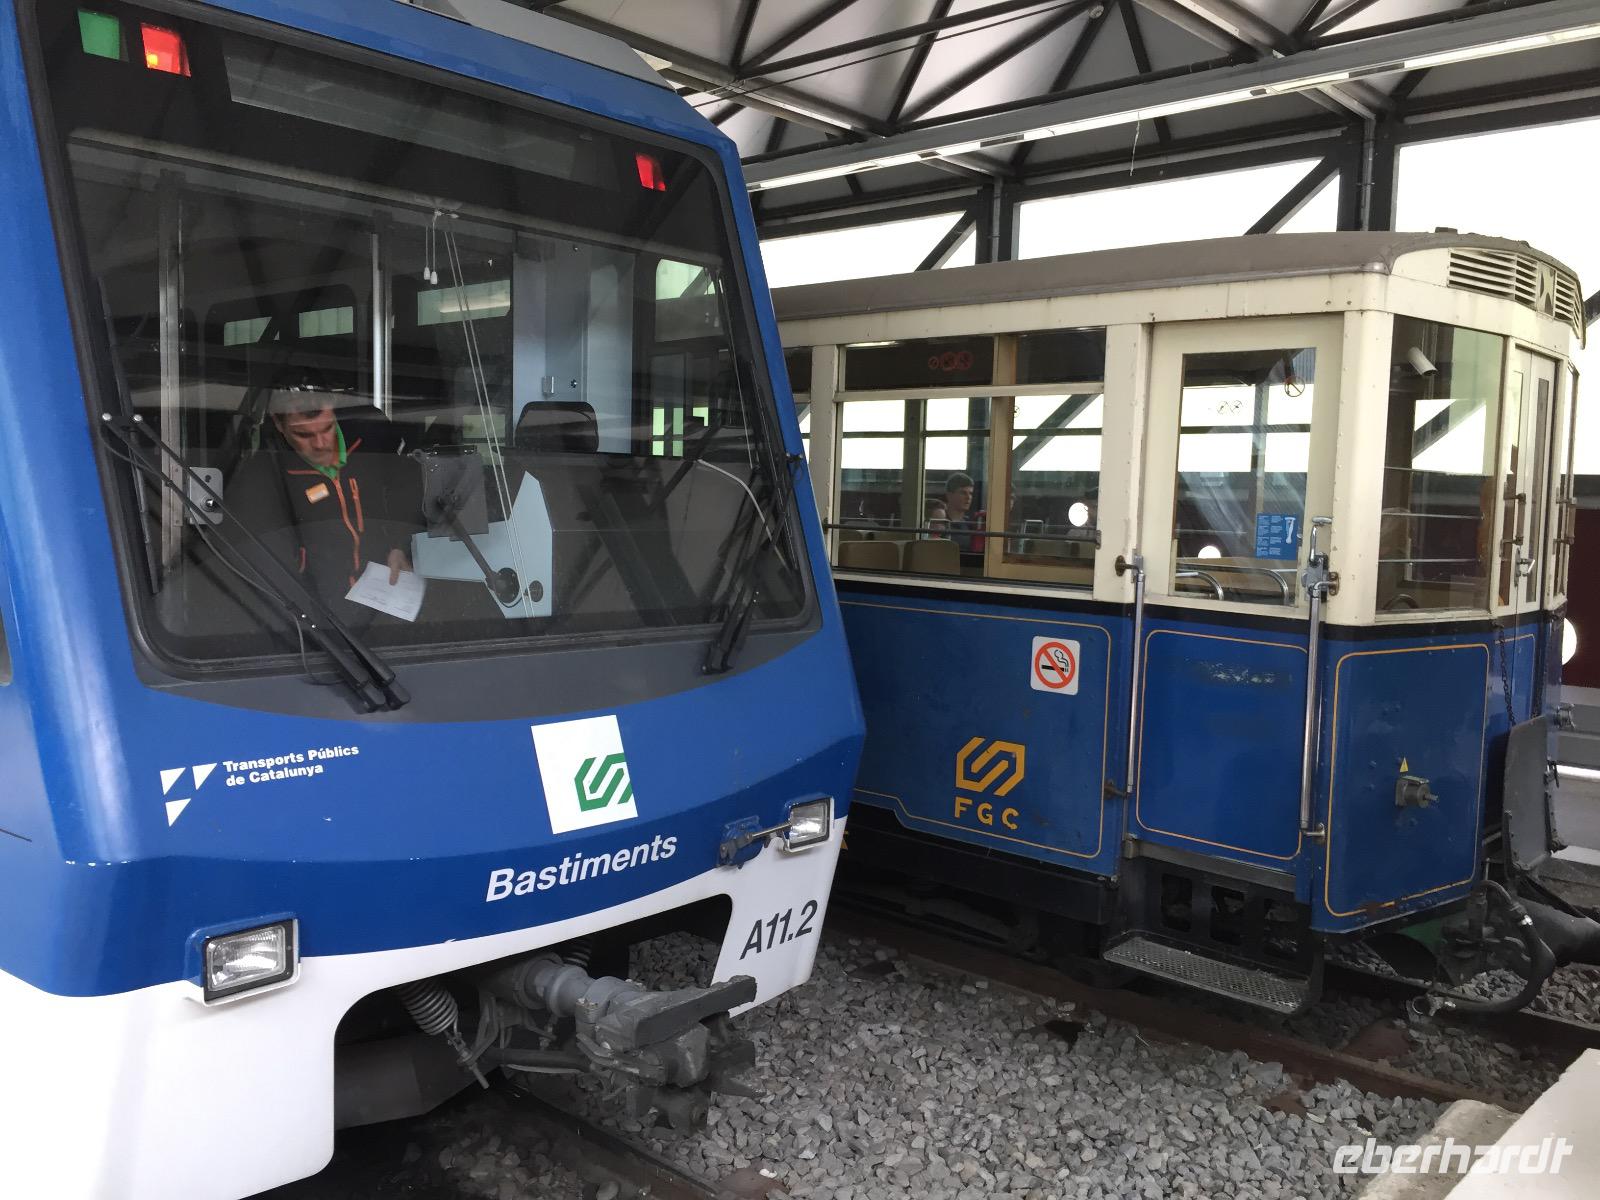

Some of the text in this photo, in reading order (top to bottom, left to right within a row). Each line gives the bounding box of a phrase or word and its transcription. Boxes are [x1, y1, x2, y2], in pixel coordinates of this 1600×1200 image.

[223, 745, 359, 772] Transports Públics
[226, 764, 324, 787] de Catalunya
[486, 834, 678, 902] Bastiments
[739, 899, 818, 960] A11.2
